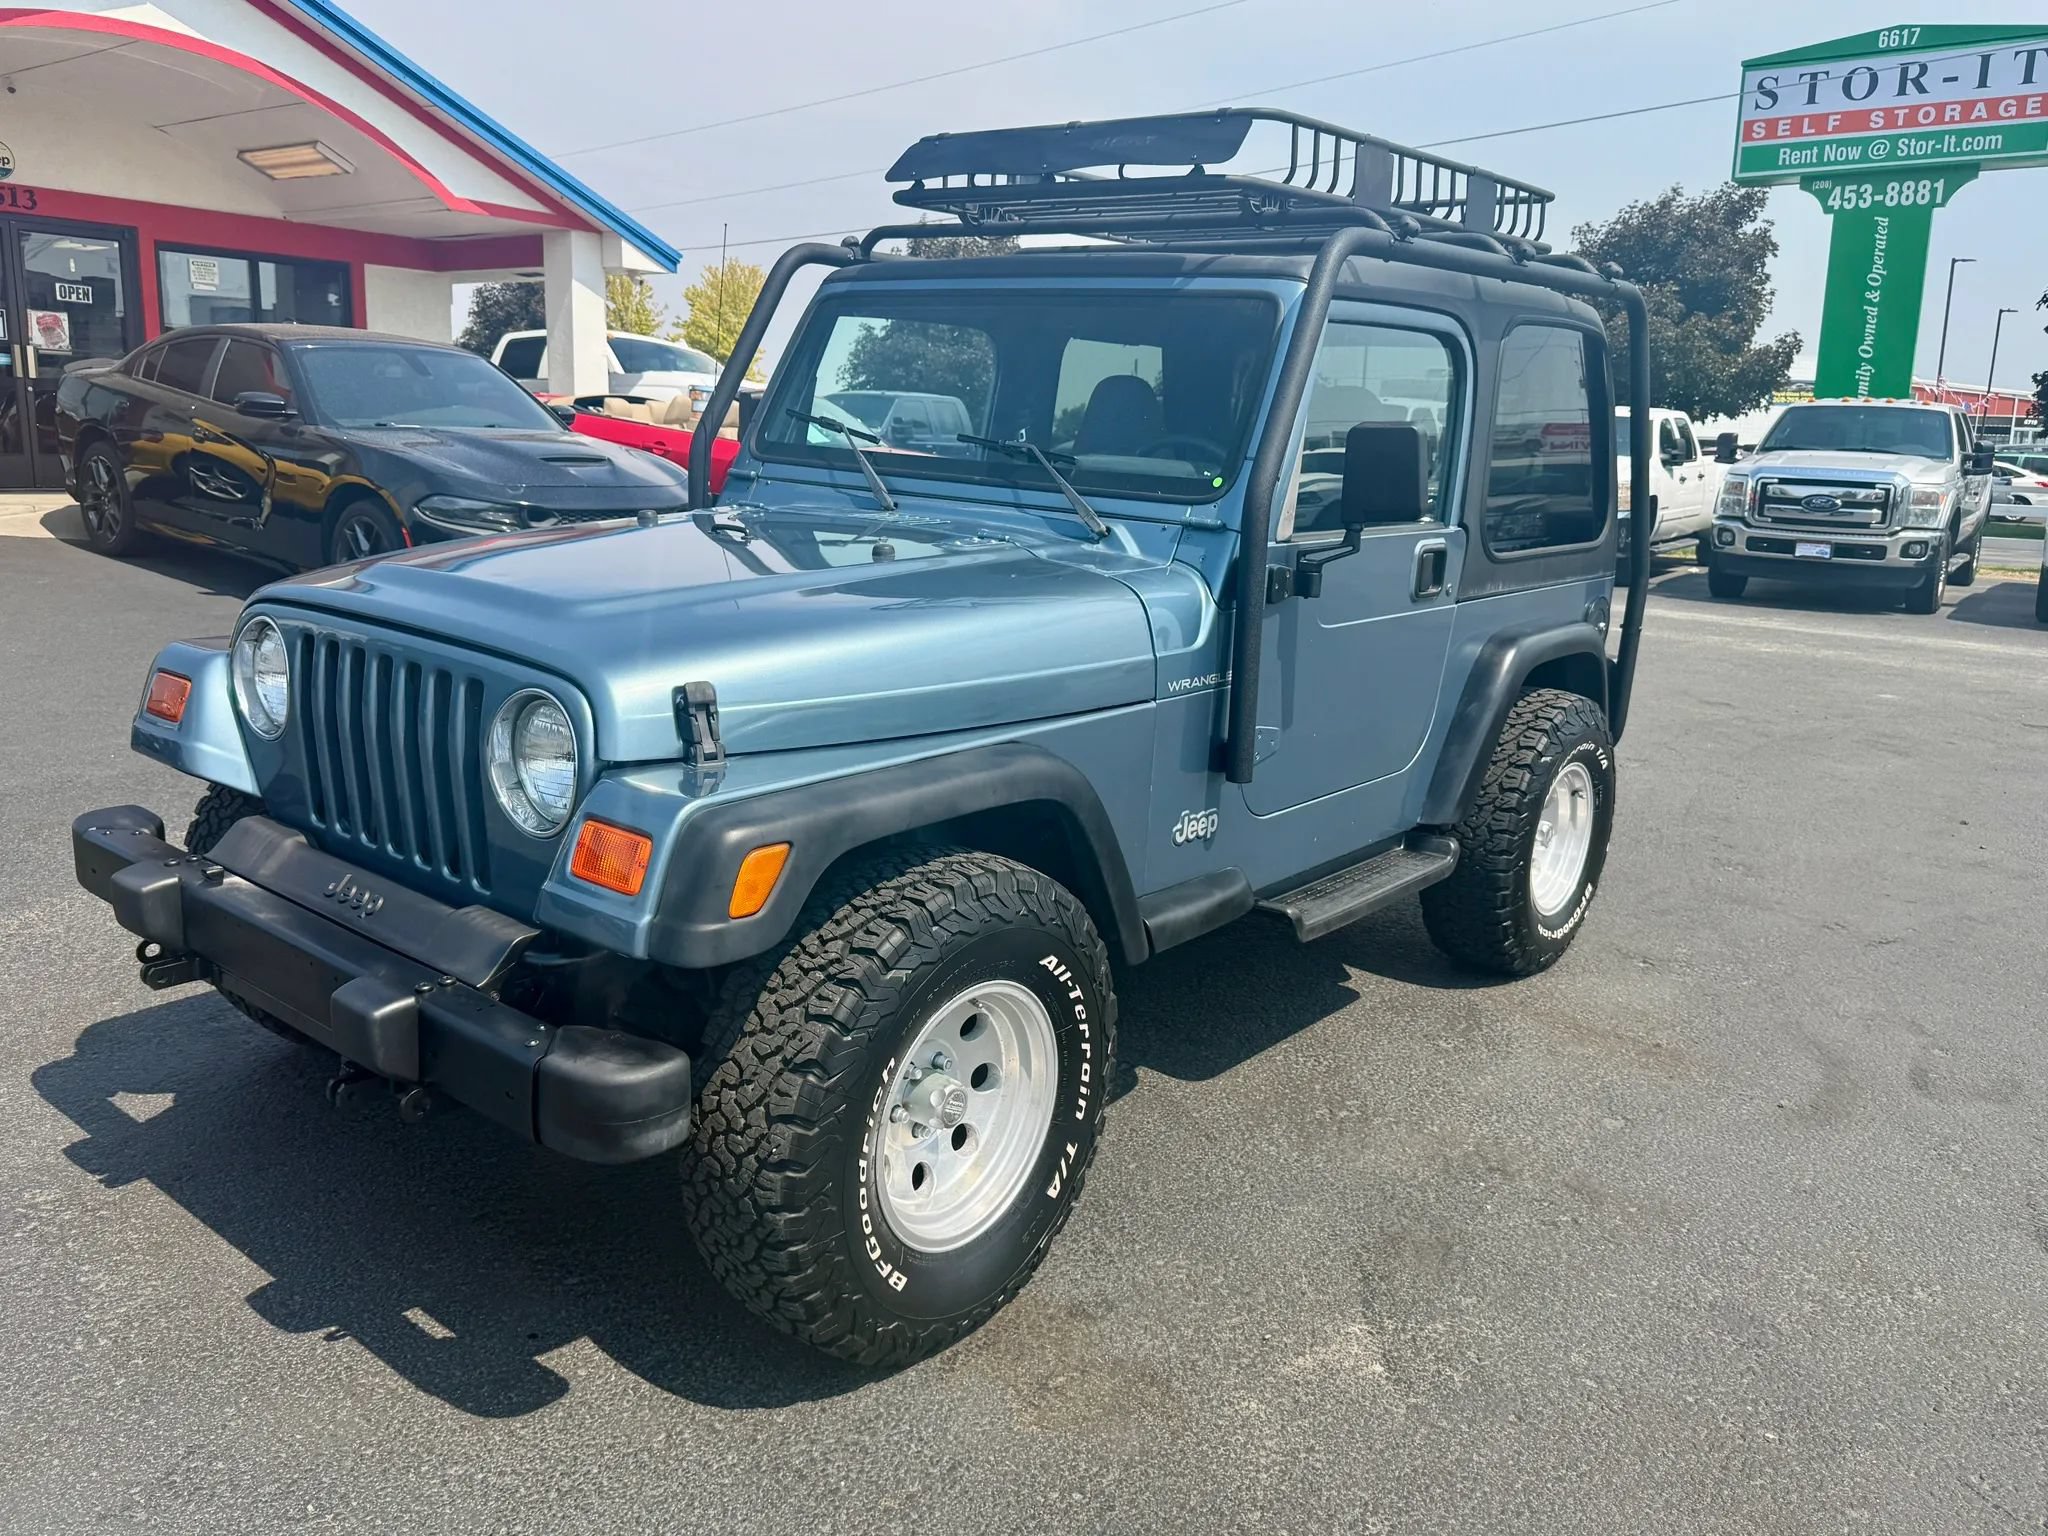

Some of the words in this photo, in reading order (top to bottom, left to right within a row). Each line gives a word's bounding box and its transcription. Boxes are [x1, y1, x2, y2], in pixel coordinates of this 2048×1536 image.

[1878, 28, 1920, 48] 6617
[1754, 48, 2048, 111] STOR-IT
[1751, 114, 1841, 139] SELF
[1869, 97, 2042, 129] STORAGE
[1778, 148, 1818, 165] Rent
[1823, 144, 1862, 161] Now
[1867, 139, 1890, 159] @
[1897, 133, 2003, 157] Stor-It.com
[1827, 178, 1946, 210] 453-8881
[1866, 216, 1890, 288] Operated
[58, 284, 90, 302] OPEN
[1865, 289, 1880, 303] &
[1858, 304, 1880, 359] Owned
[1855, 362, 1875, 397] mily
[1173, 809, 1219, 847] Jeep
[323, 874, 384, 919] Jeep
[1038, 955, 1092, 1120] All-Terrain
[858, 1057, 908, 1292] BFGoodrich
[1047, 1142, 1078, 1199] T/A
